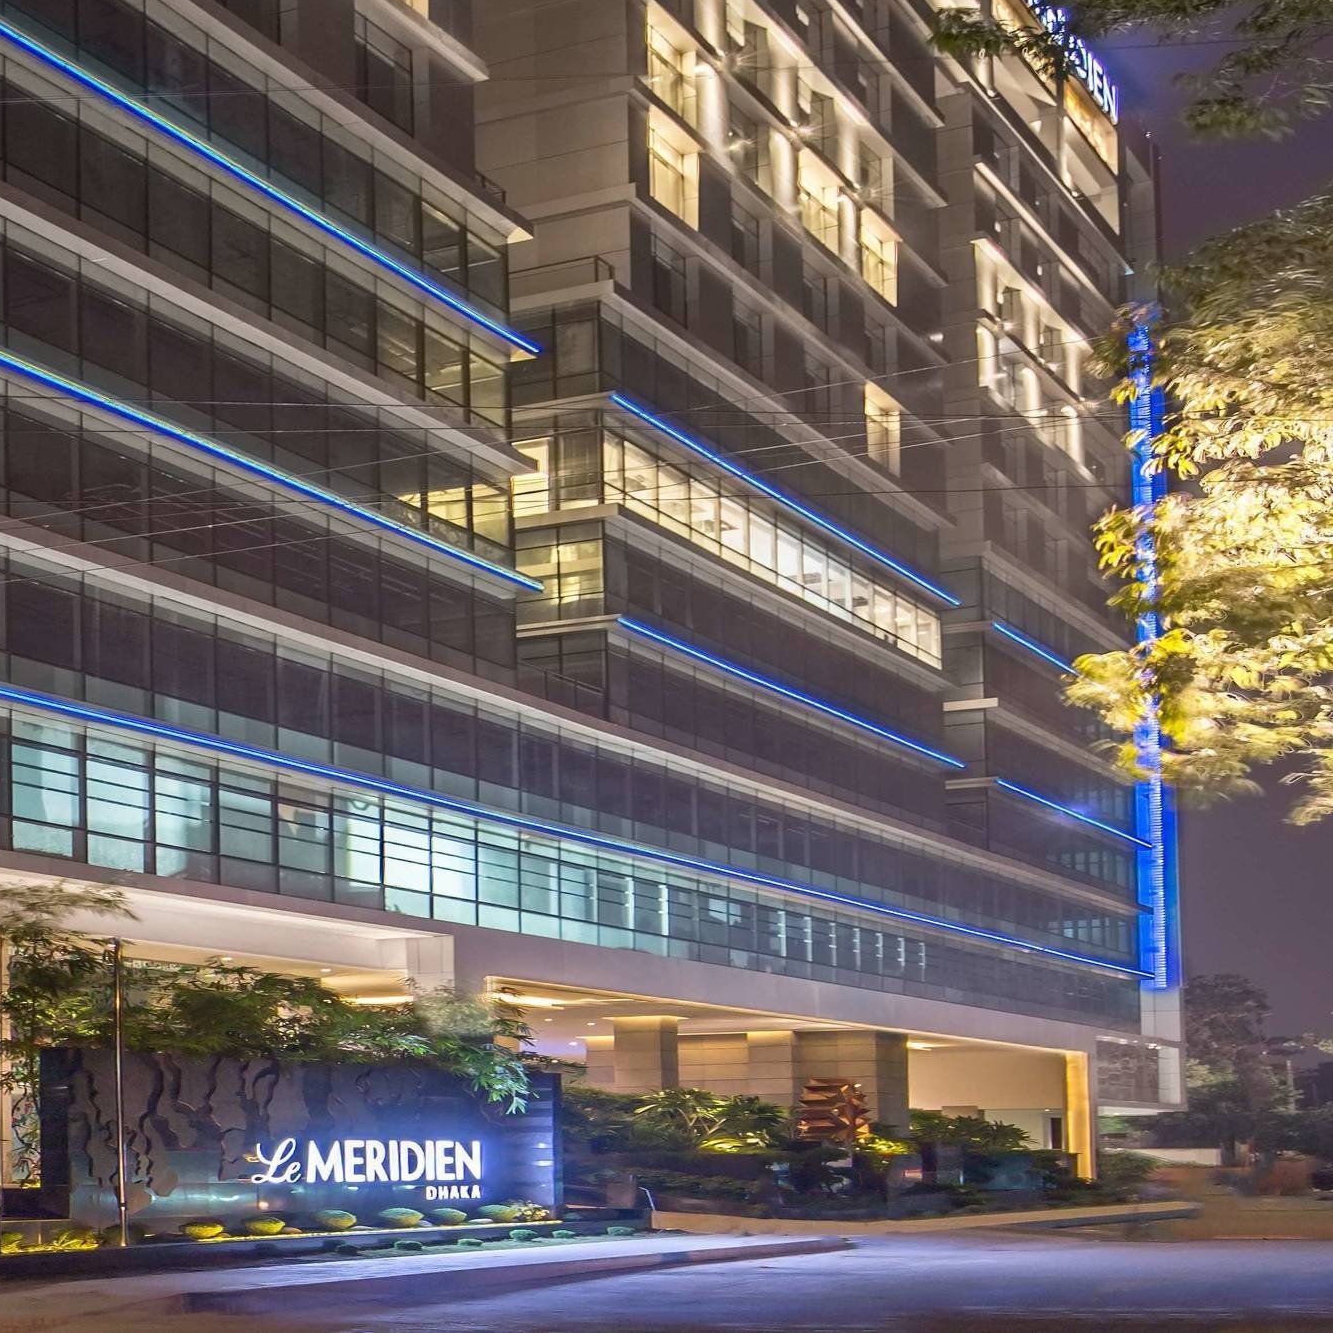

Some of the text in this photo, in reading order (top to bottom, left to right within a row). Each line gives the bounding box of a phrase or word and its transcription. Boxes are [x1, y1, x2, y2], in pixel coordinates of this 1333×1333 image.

[251, 1137, 482, 1184] Le MERIDIEN
[425, 1185, 482, 1201] DHAKA
